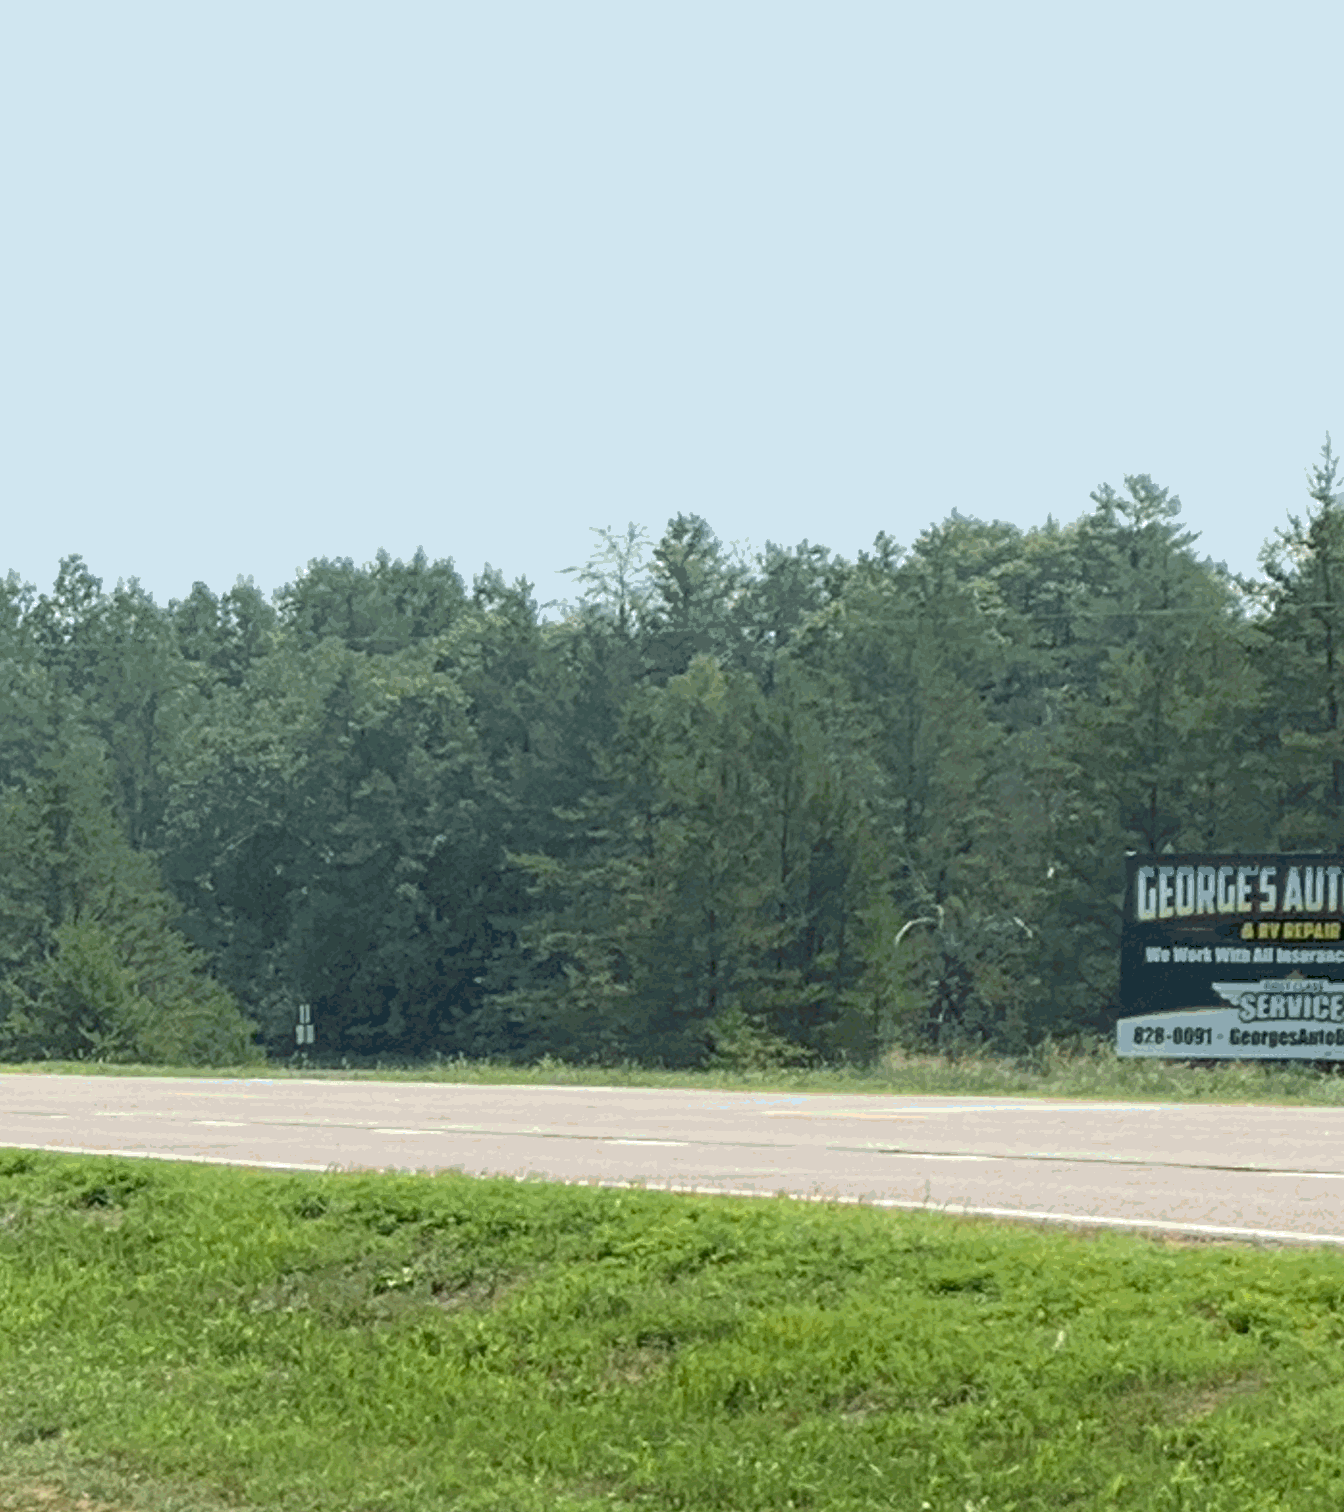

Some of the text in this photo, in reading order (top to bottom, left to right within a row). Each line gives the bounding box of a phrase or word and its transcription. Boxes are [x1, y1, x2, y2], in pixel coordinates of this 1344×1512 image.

[1282, 866, 1344, 912] AUT
[1241, 922, 1254, 939] &
[1283, 922, 1341, 939] REPAIR
[1173, 947, 1212, 963] Work
[1134, 1026, 1212, 1045] 828-0091
